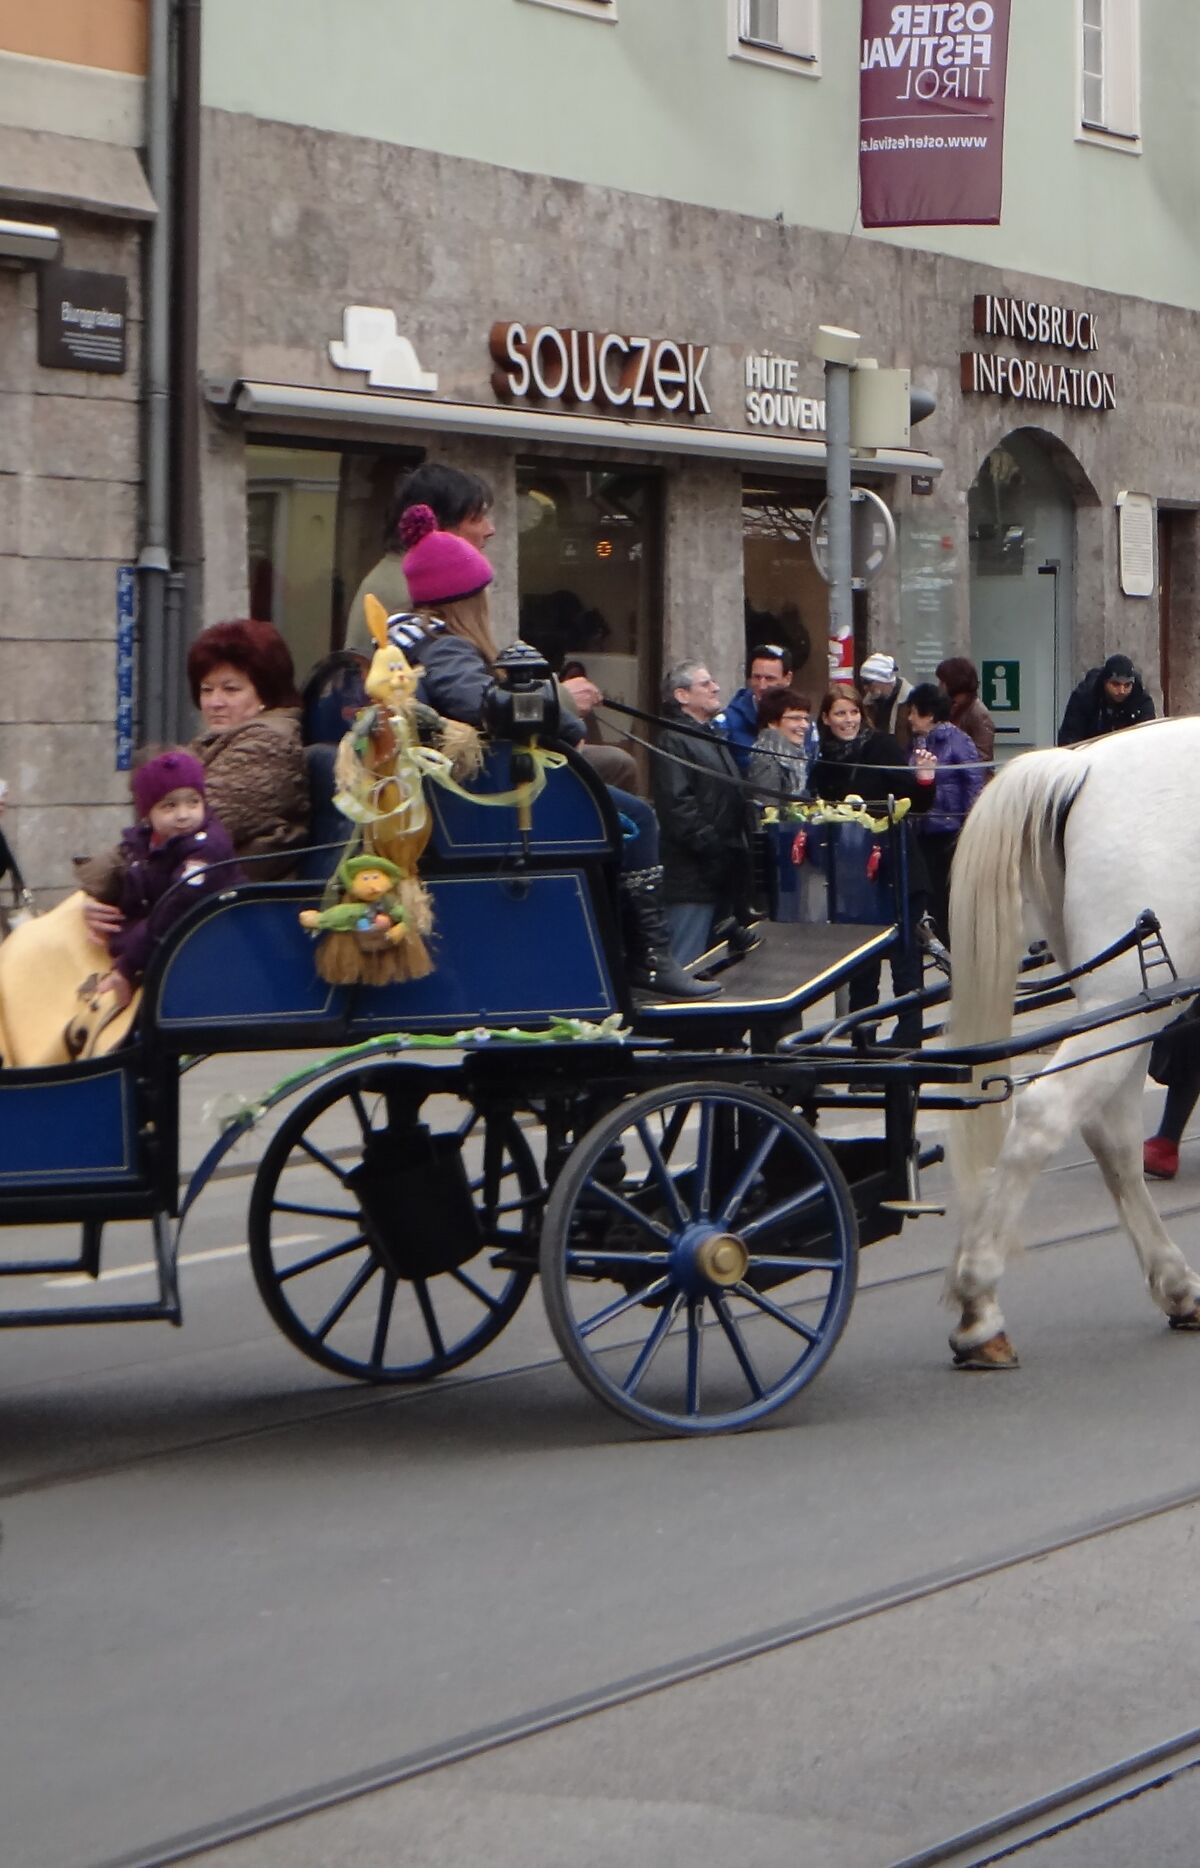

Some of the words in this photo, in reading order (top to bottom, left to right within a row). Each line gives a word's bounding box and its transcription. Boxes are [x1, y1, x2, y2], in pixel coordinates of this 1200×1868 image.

[985, 294, 1099, 350] INNSBRUCK
[745, 348, 799, 392] HÜTE
[972, 352, 1117, 409] INFORMATION
